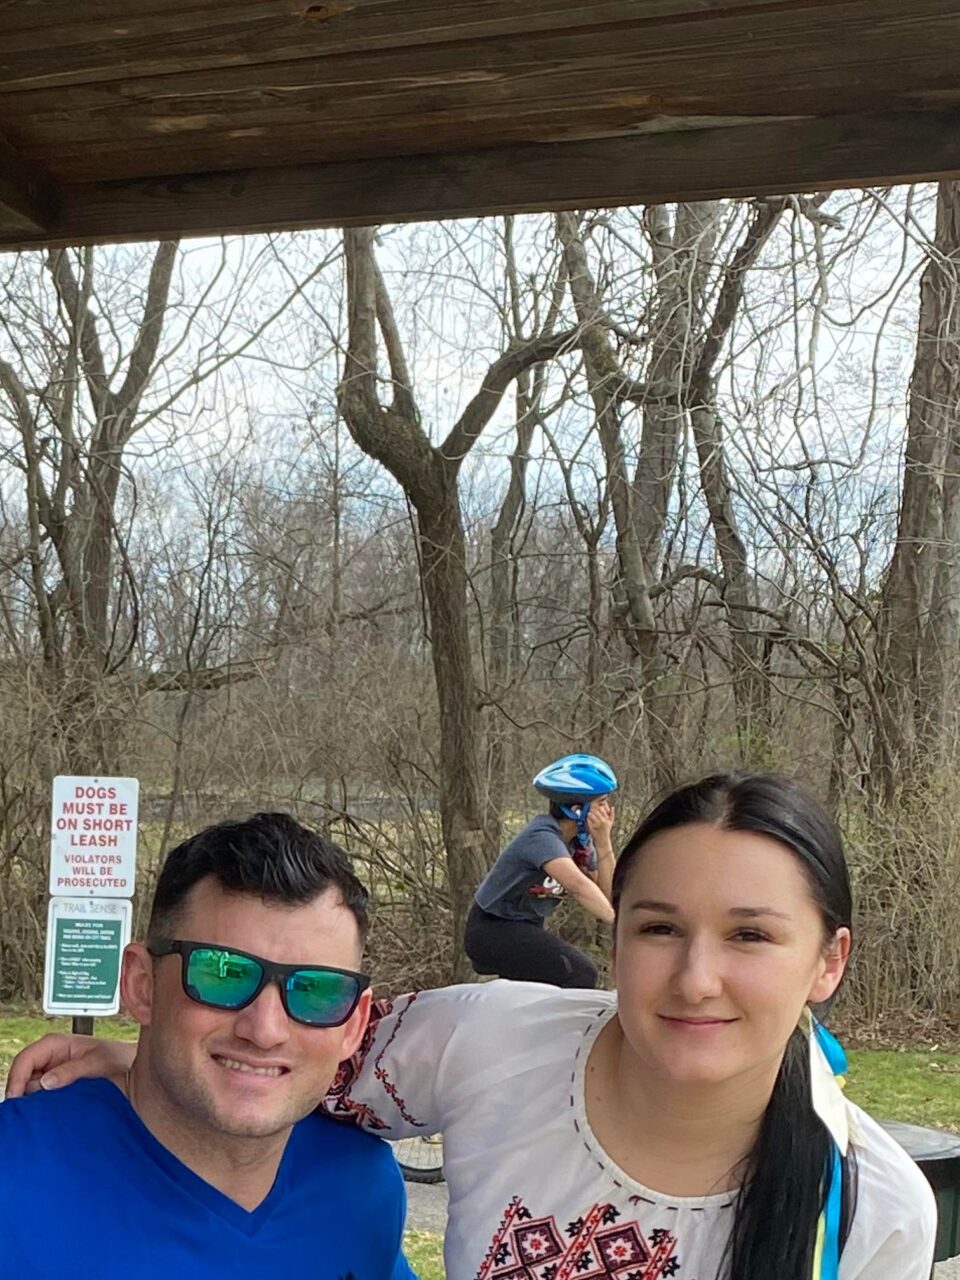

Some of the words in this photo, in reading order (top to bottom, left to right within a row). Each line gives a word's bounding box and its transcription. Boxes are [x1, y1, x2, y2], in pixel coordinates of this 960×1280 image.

[75, 787, 117, 799] DOGS
[63, 802, 104, 815] MUST
[109, 803, 128, 815] BE
[56, 818, 78, 830] ON
[82, 819, 133, 831] SHORT
[70, 834, 118, 847] LEASH
[64, 854, 122, 864] VIOLATORS
[72, 866, 96, 876] WILL
[99, 867, 113, 876] BE
[57, 877, 127, 888] PROSECUTED
[63, 902, 86, 914] TRAIL
[89, 903, 118, 915] SENSE
